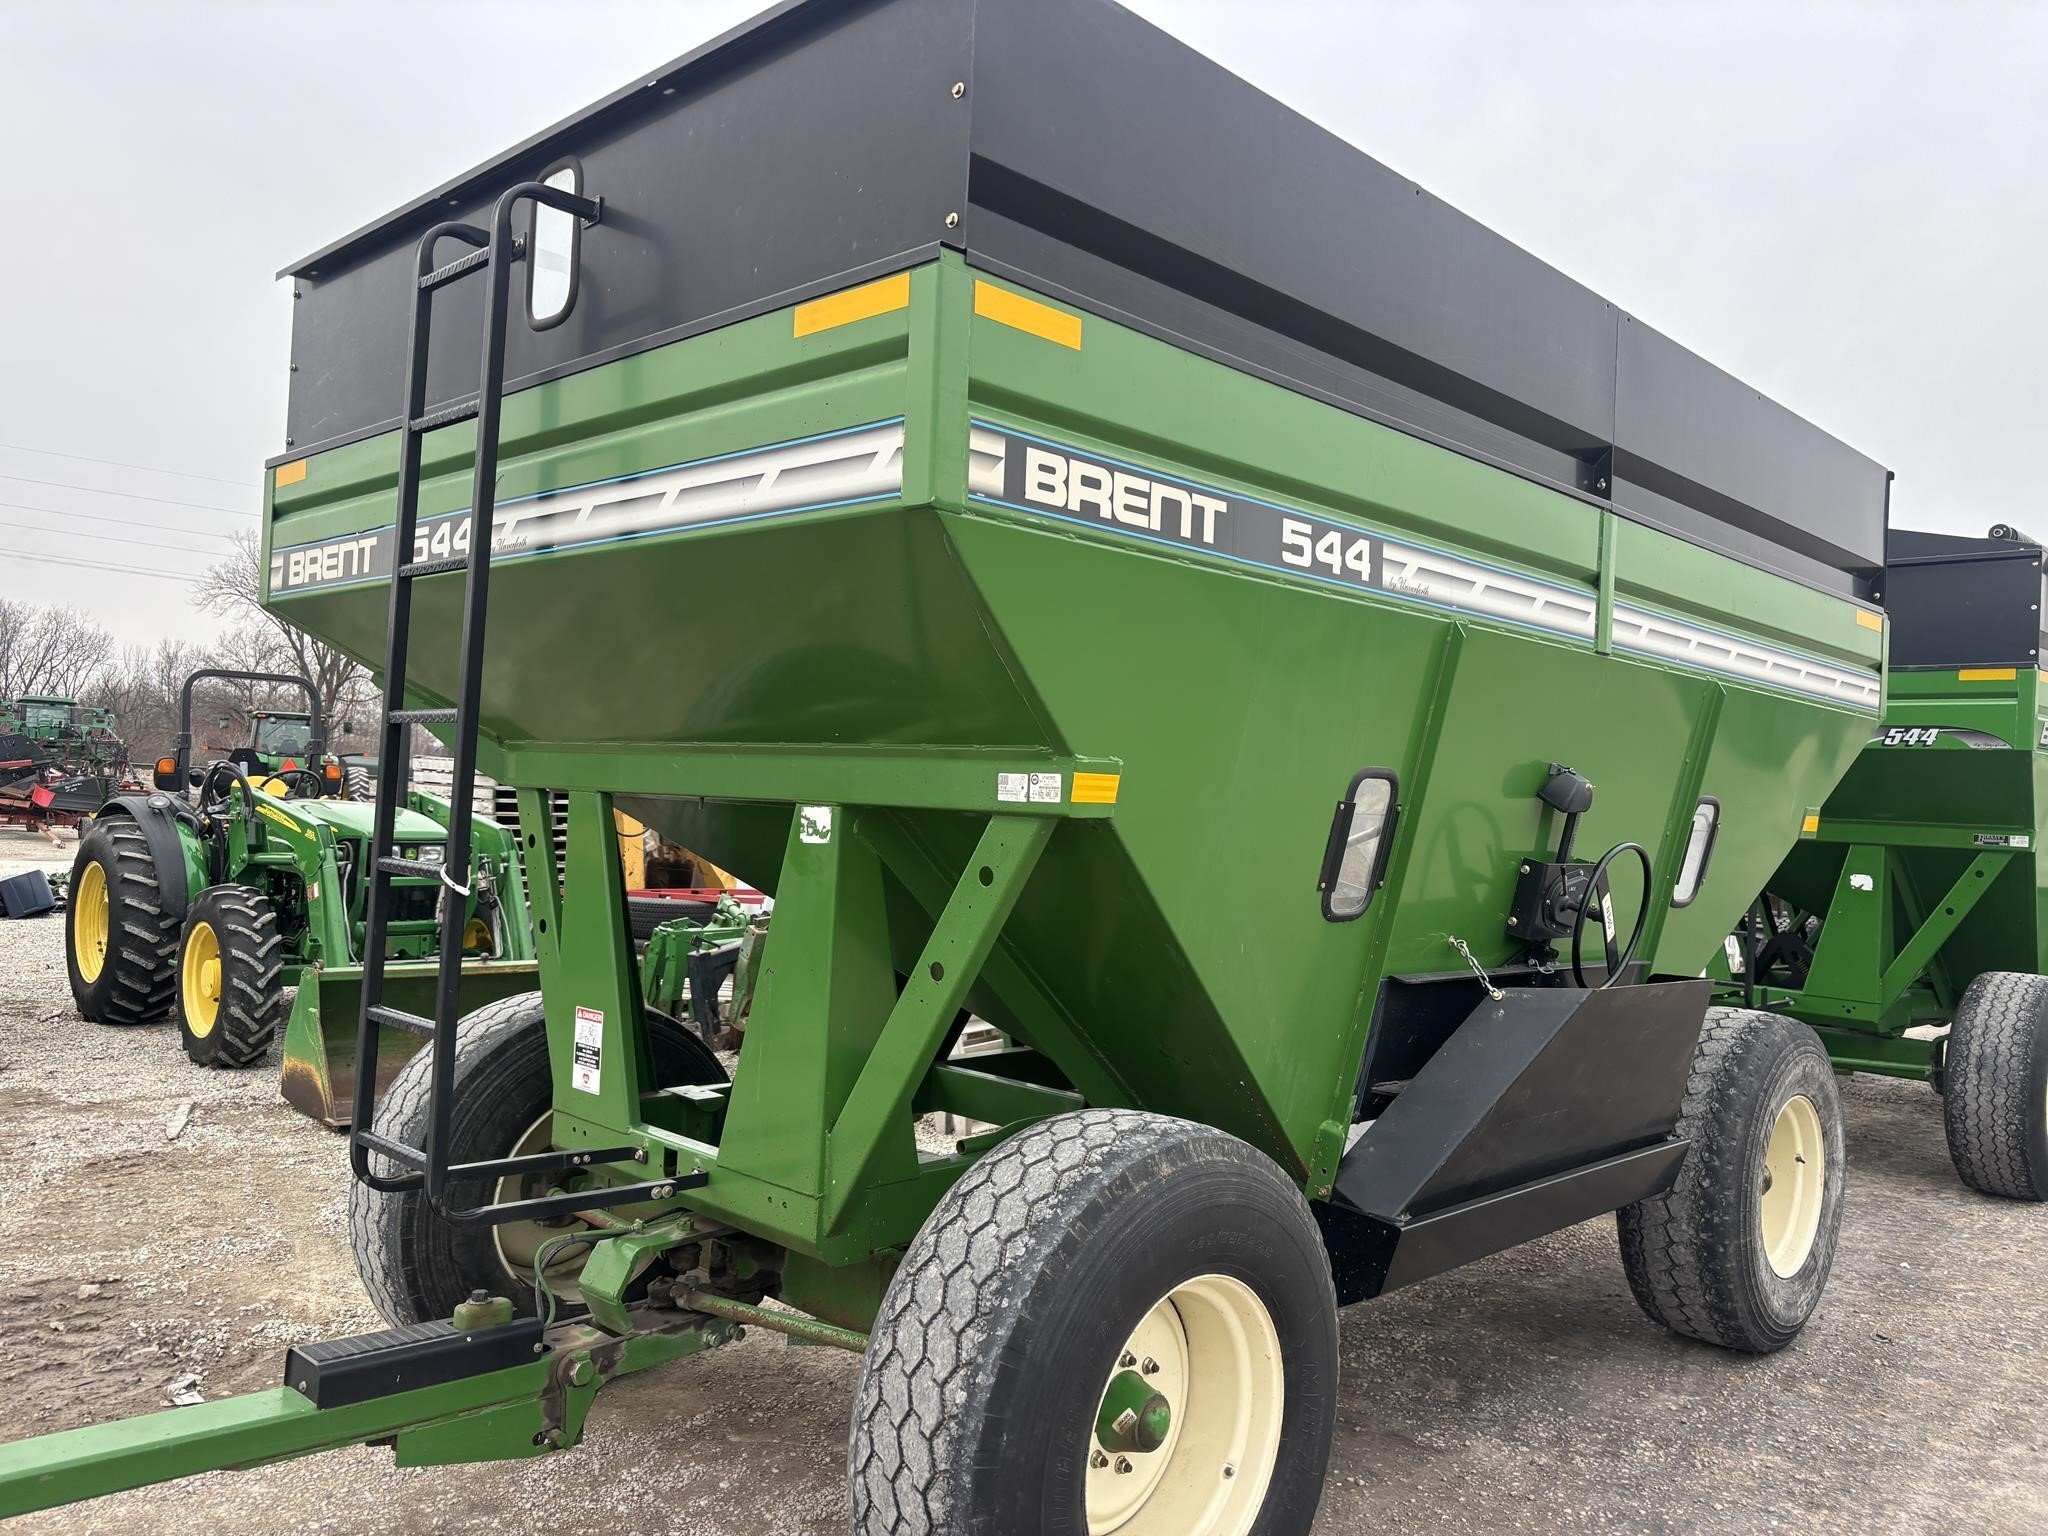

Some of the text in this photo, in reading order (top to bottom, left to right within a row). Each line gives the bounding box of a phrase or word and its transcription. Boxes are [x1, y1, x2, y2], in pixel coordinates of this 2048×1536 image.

[1025, 447, 1227, 544] BRENT
[1282, 518, 1371, 582] 544
[288, 536, 378, 586] BRENT
[413, 517, 471, 563] 544
[1882, 728, 1940, 747] 544
